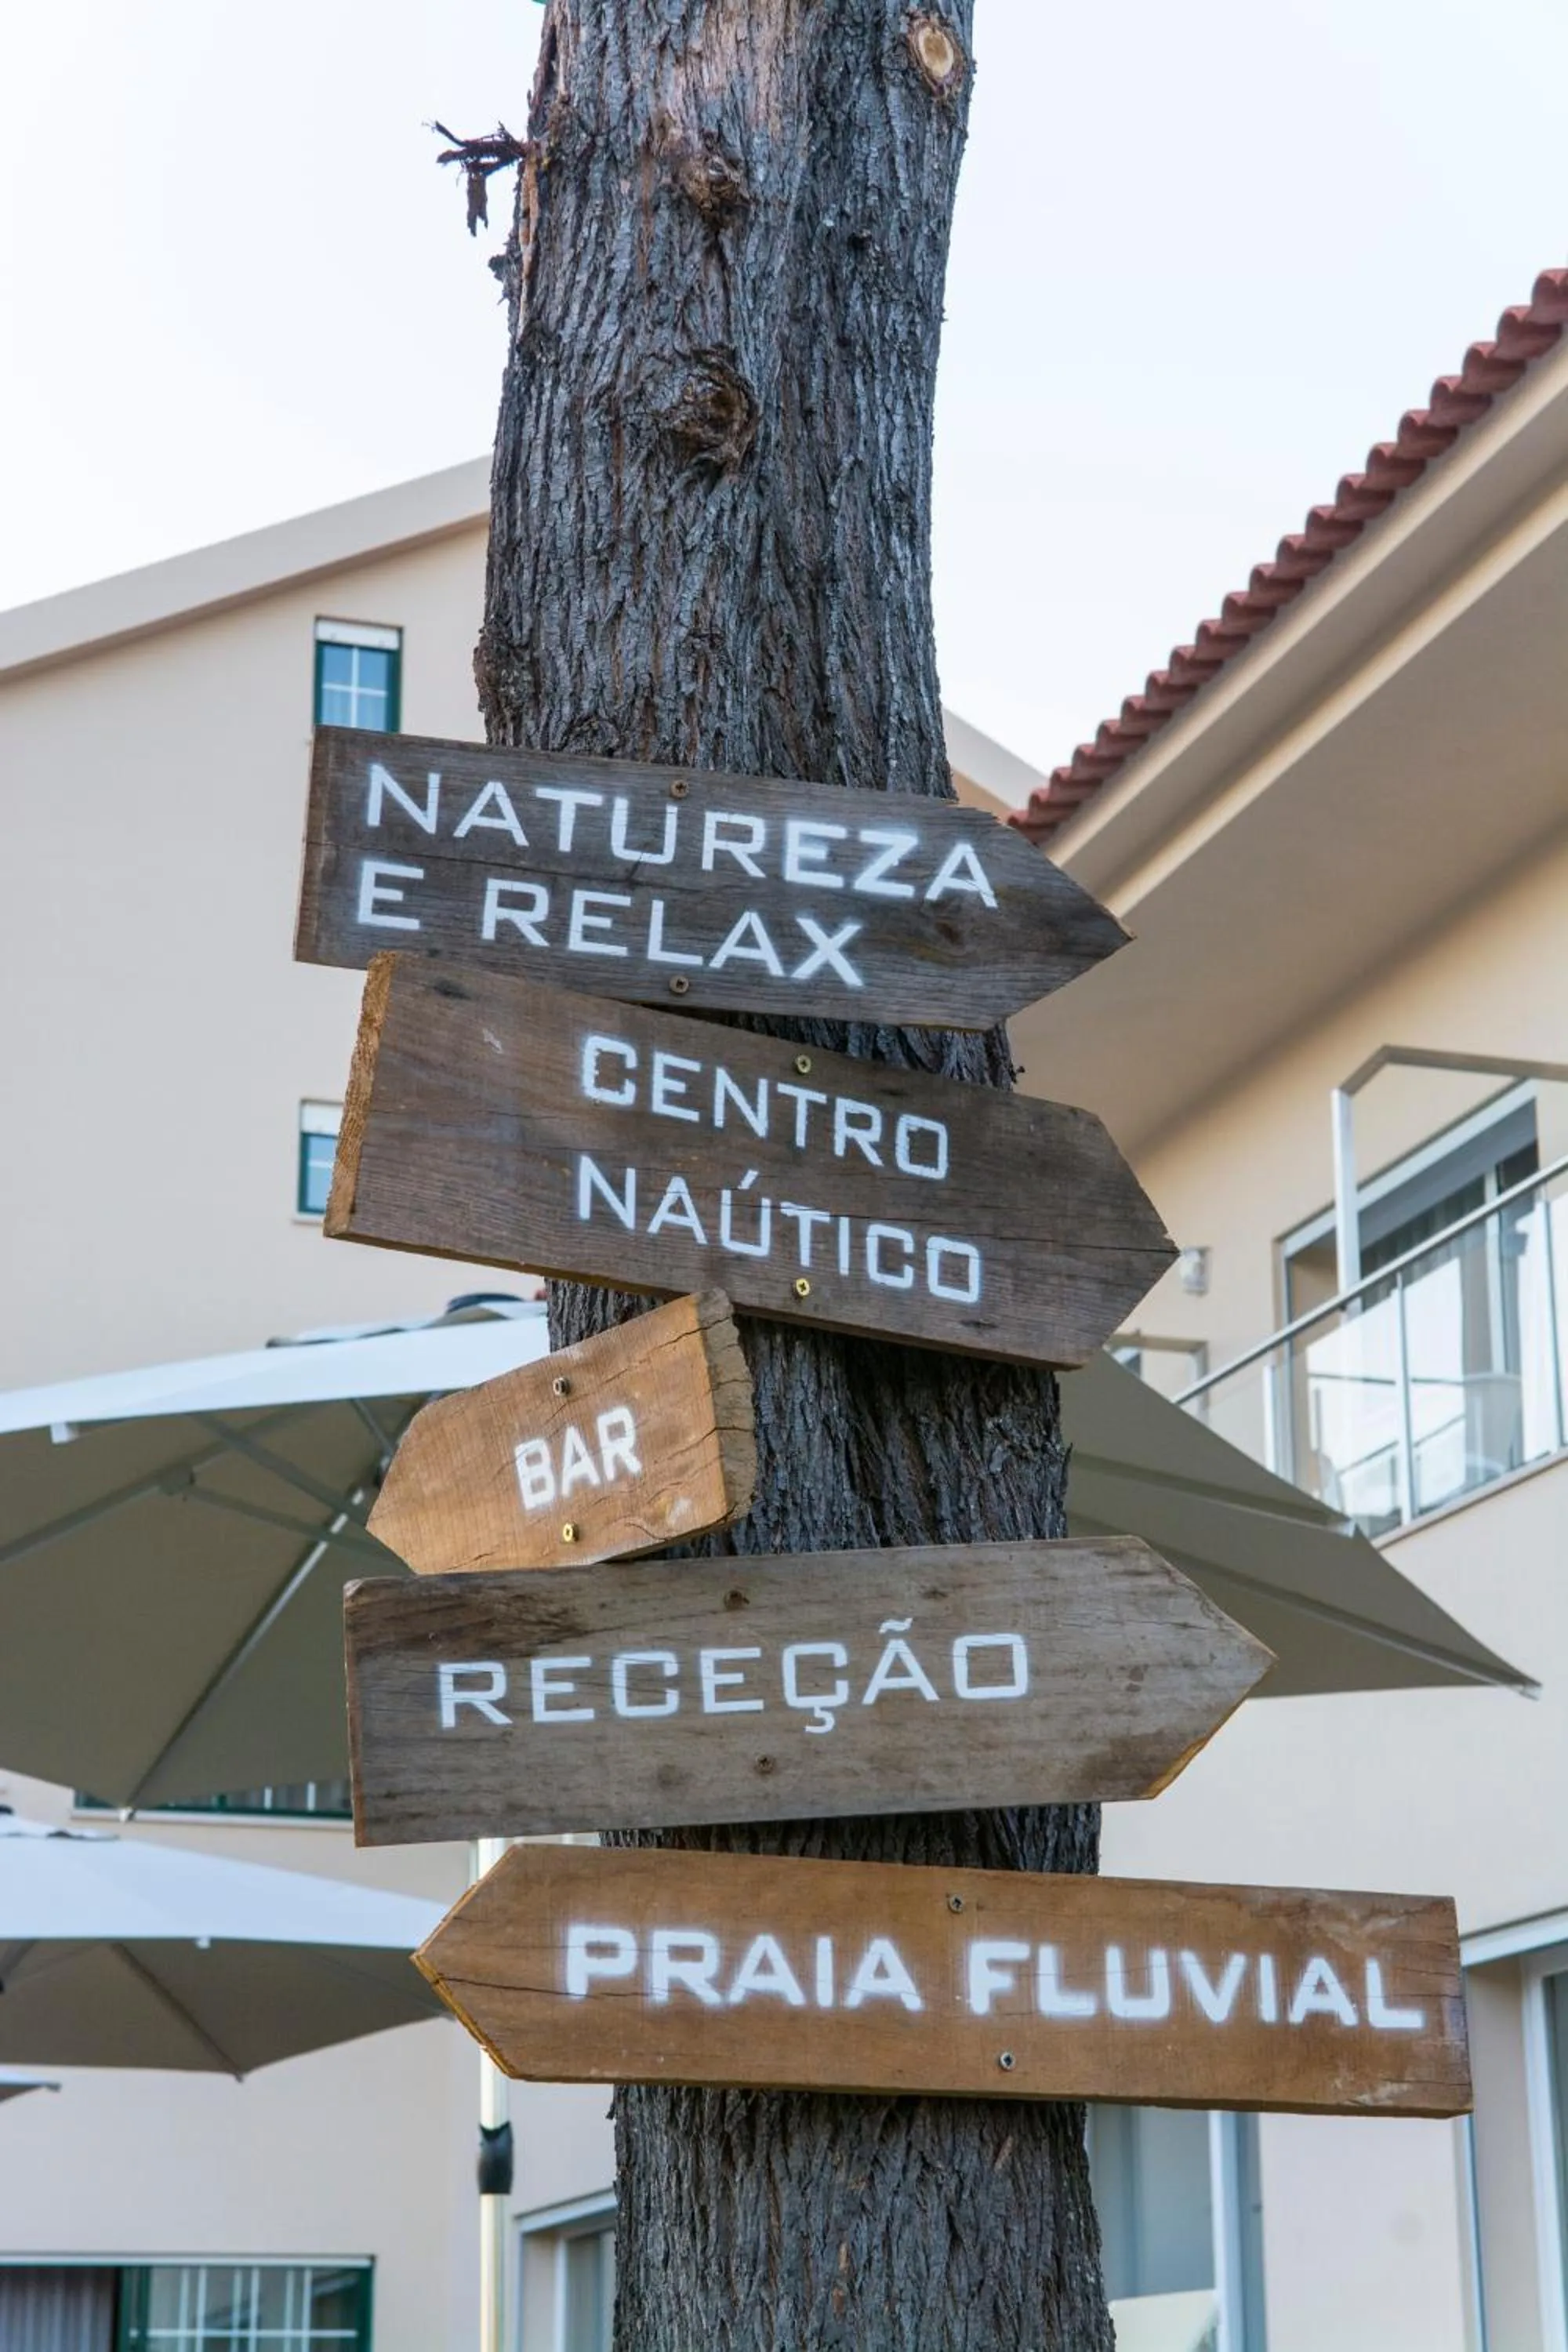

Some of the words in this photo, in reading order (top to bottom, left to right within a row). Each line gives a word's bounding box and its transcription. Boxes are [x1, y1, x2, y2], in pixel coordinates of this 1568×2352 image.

[365, 762, 999, 909] NATUREZA
[356, 858, 425, 931] E
[481, 877, 864, 989] RELAX
[580, 1033, 949, 1180] CENTRO
[577, 1154, 982, 1305] NAÚTICO
[514, 1405, 642, 1512] BAR
[437, 1617, 1030, 1734] RECEÇÃO
[564, 1922, 924, 2013] PRAIA
[964, 1938, 1425, 2030] FLUVIAL
